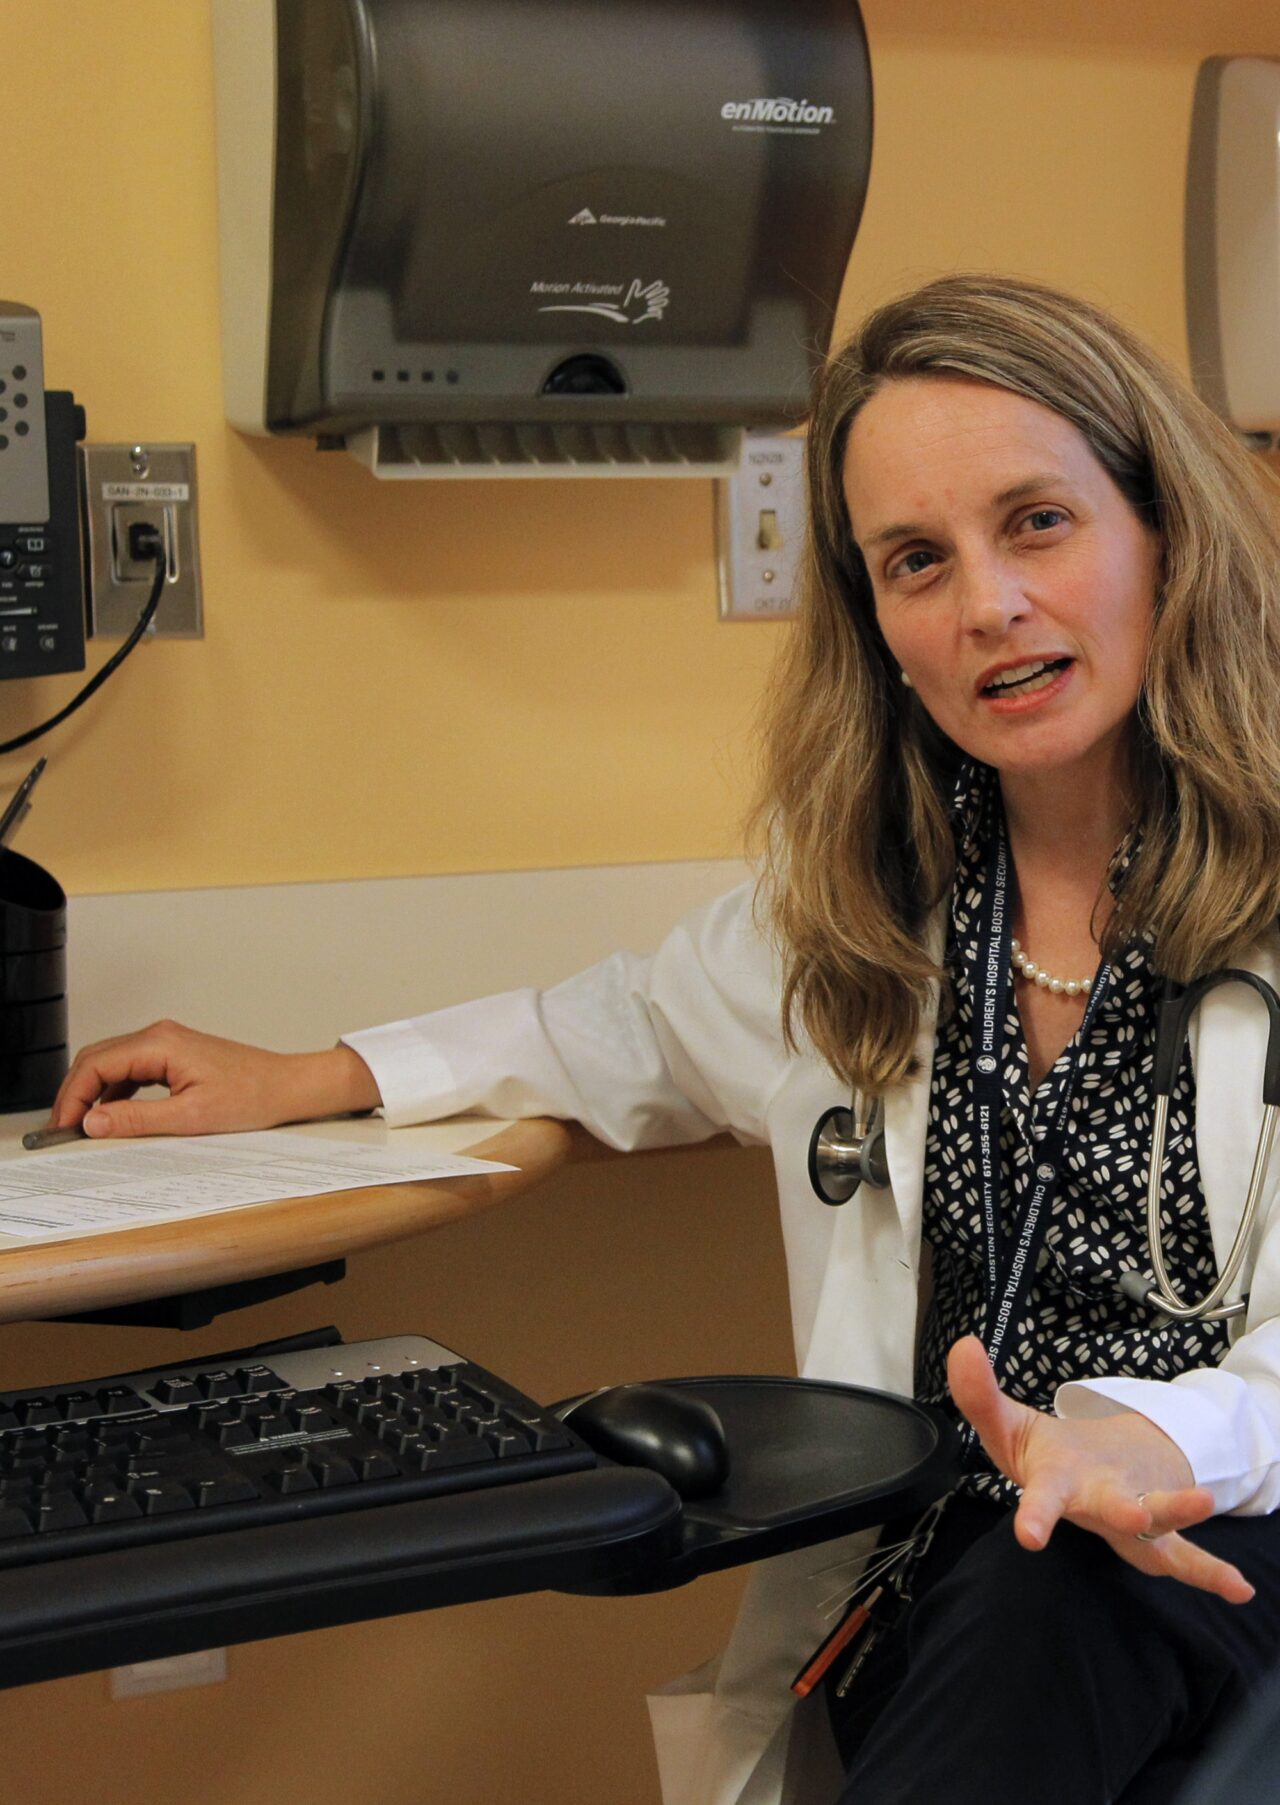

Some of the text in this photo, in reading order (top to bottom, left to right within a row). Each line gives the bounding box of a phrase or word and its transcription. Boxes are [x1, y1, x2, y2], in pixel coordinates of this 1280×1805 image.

[720, 98, 834, 124] enMotion
[529, 281, 624, 296] Motion Activated
[995, 840, 1008, 888] SECURITY
[991, 889, 1005, 933] BOSTON
[986, 935, 1001, 986] HOSPITAL
[982, 988, 996, 1052] CHILDREN'S
[980, 1105, 992, 1178] 617-355-6121
[983, 1181, 995, 1234] SECURITY
[1019, 1184, 1046, 1247] CHILDREN'S
[987, 1236, 997, 1281] BOSTON
[1003, 1247, 1028, 1300] HOSPITAL
[992, 1300, 1013, 1346] BOSTON
